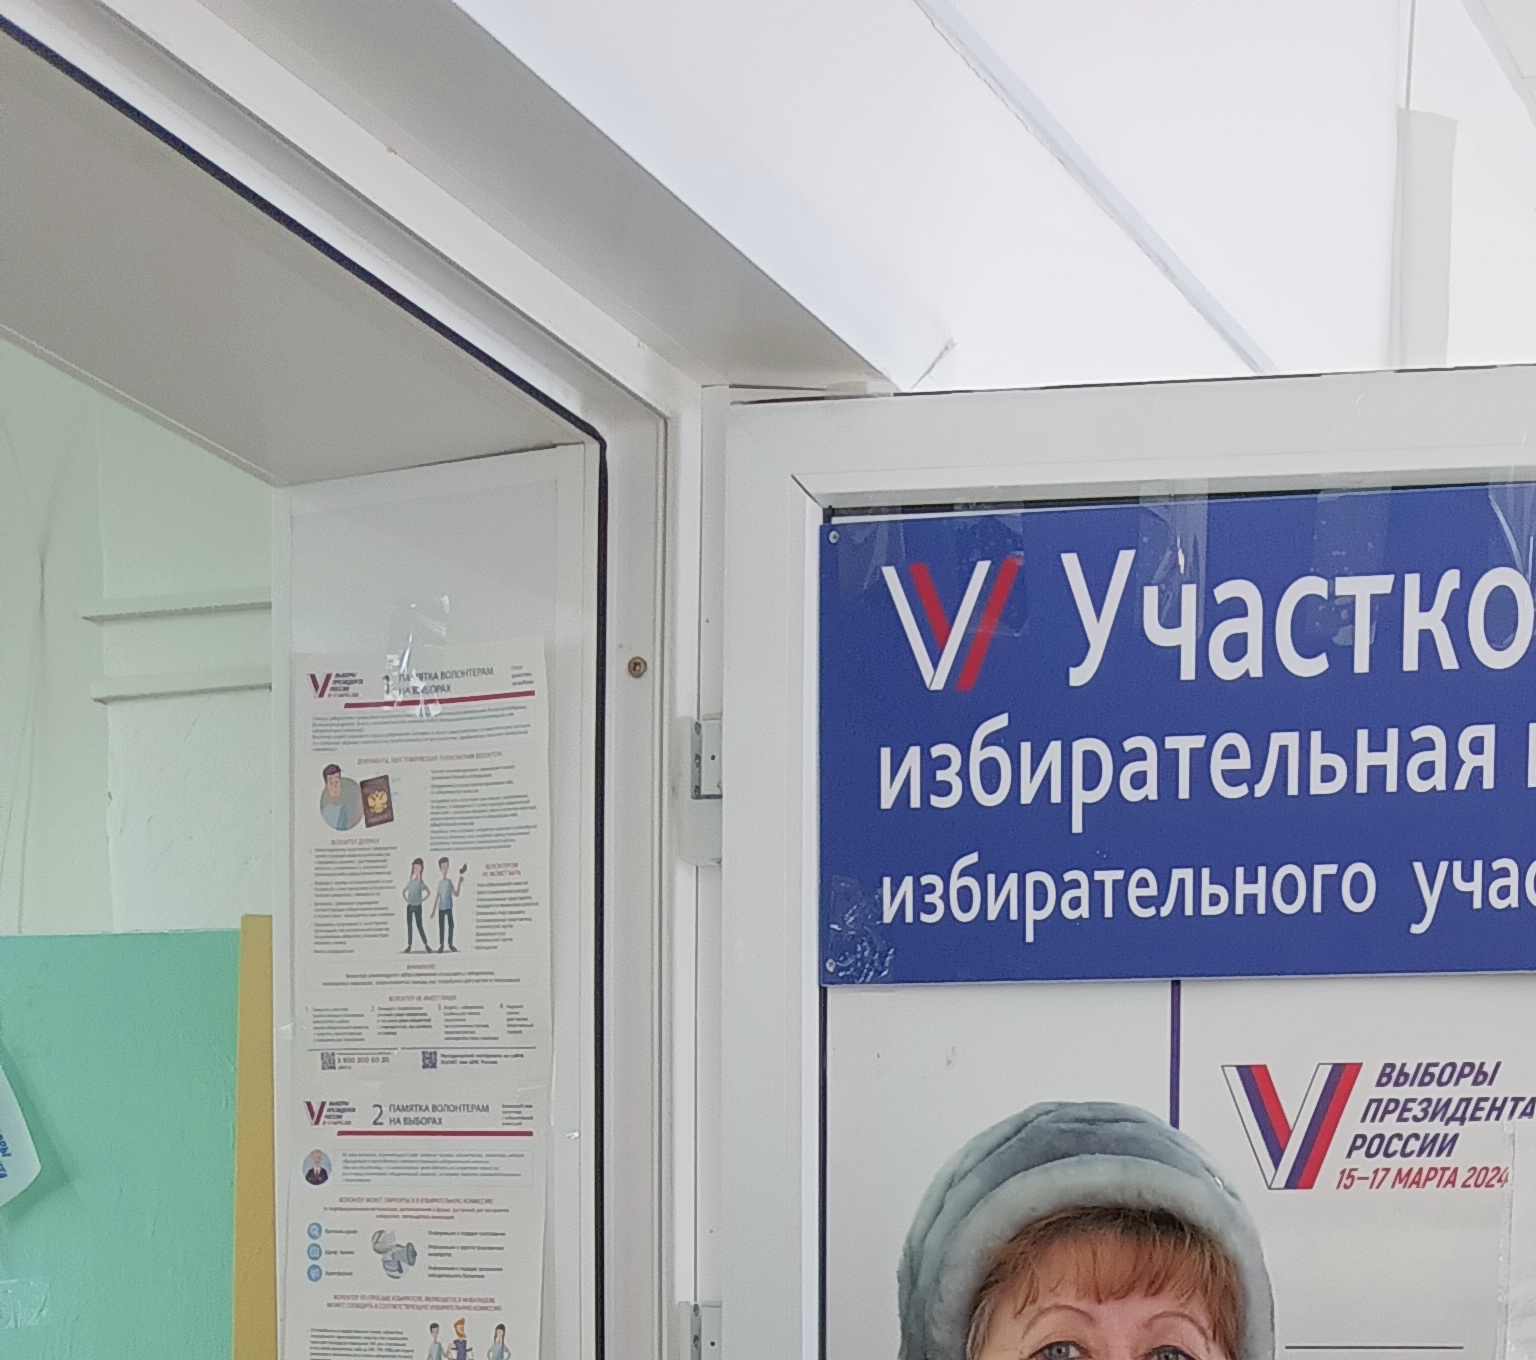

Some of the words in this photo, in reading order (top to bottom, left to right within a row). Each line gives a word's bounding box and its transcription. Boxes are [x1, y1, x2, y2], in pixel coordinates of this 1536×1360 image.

[399, 671, 439, 682] ПАЯТКА
[440, 667, 494, 680] ВОЛОНТЕРАМ
[878, 712, 1497, 834] избирательная
[880, 852, 1378, 944] избирательного
[1375, 1061, 1502, 1087] ВЫБОРЫ
[372, 1104, 384, 1126] 2
[388, 1104, 429, 1113] ПАМЯТКА
[432, 1104, 489, 1113] ВОЛОНТЕРАМ
[1360, 1097, 1536, 1126] ПРЕЗИДЕНТА
[388, 1117, 401, 1126] НА
[403, 1117, 443, 1126] ВЫБОРАХ
[1346, 1132, 1459, 1159] РОССИИ
[1391, 1167, 1458, 1189] МАРТА
[1461, 1166, 1509, 1189] 2024
